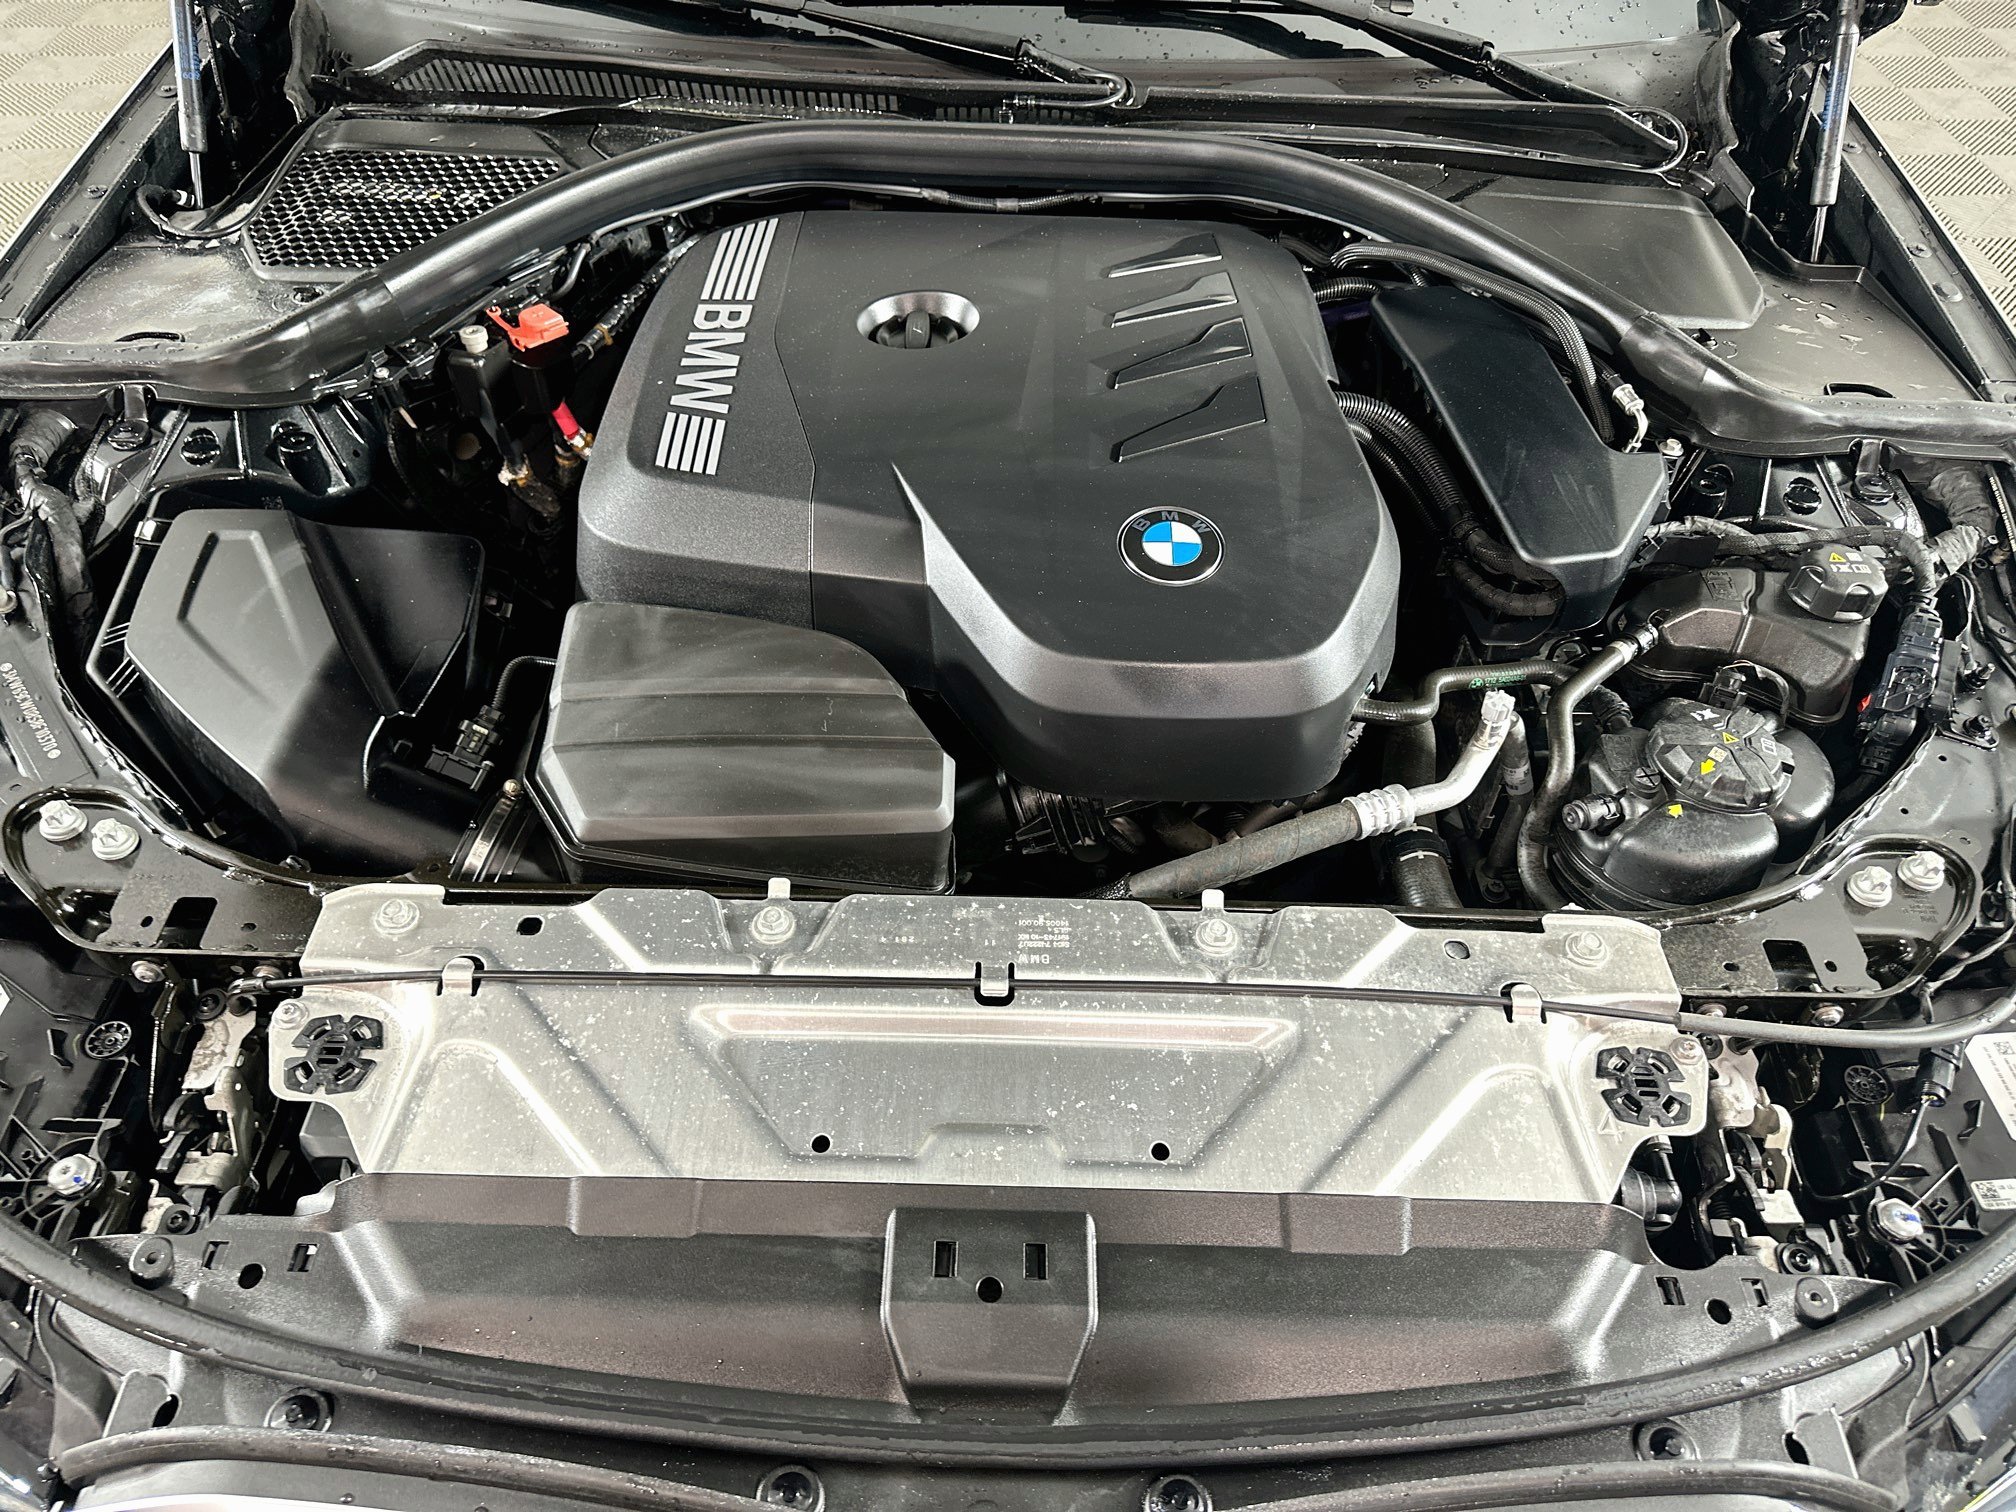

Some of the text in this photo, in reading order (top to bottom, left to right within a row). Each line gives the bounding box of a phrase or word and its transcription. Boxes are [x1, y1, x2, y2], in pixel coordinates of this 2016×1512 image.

[670, 304, 753, 414] BMW
[1131, 511, 1211, 533] BMW
[1018, 953, 1050, 965] BMW
